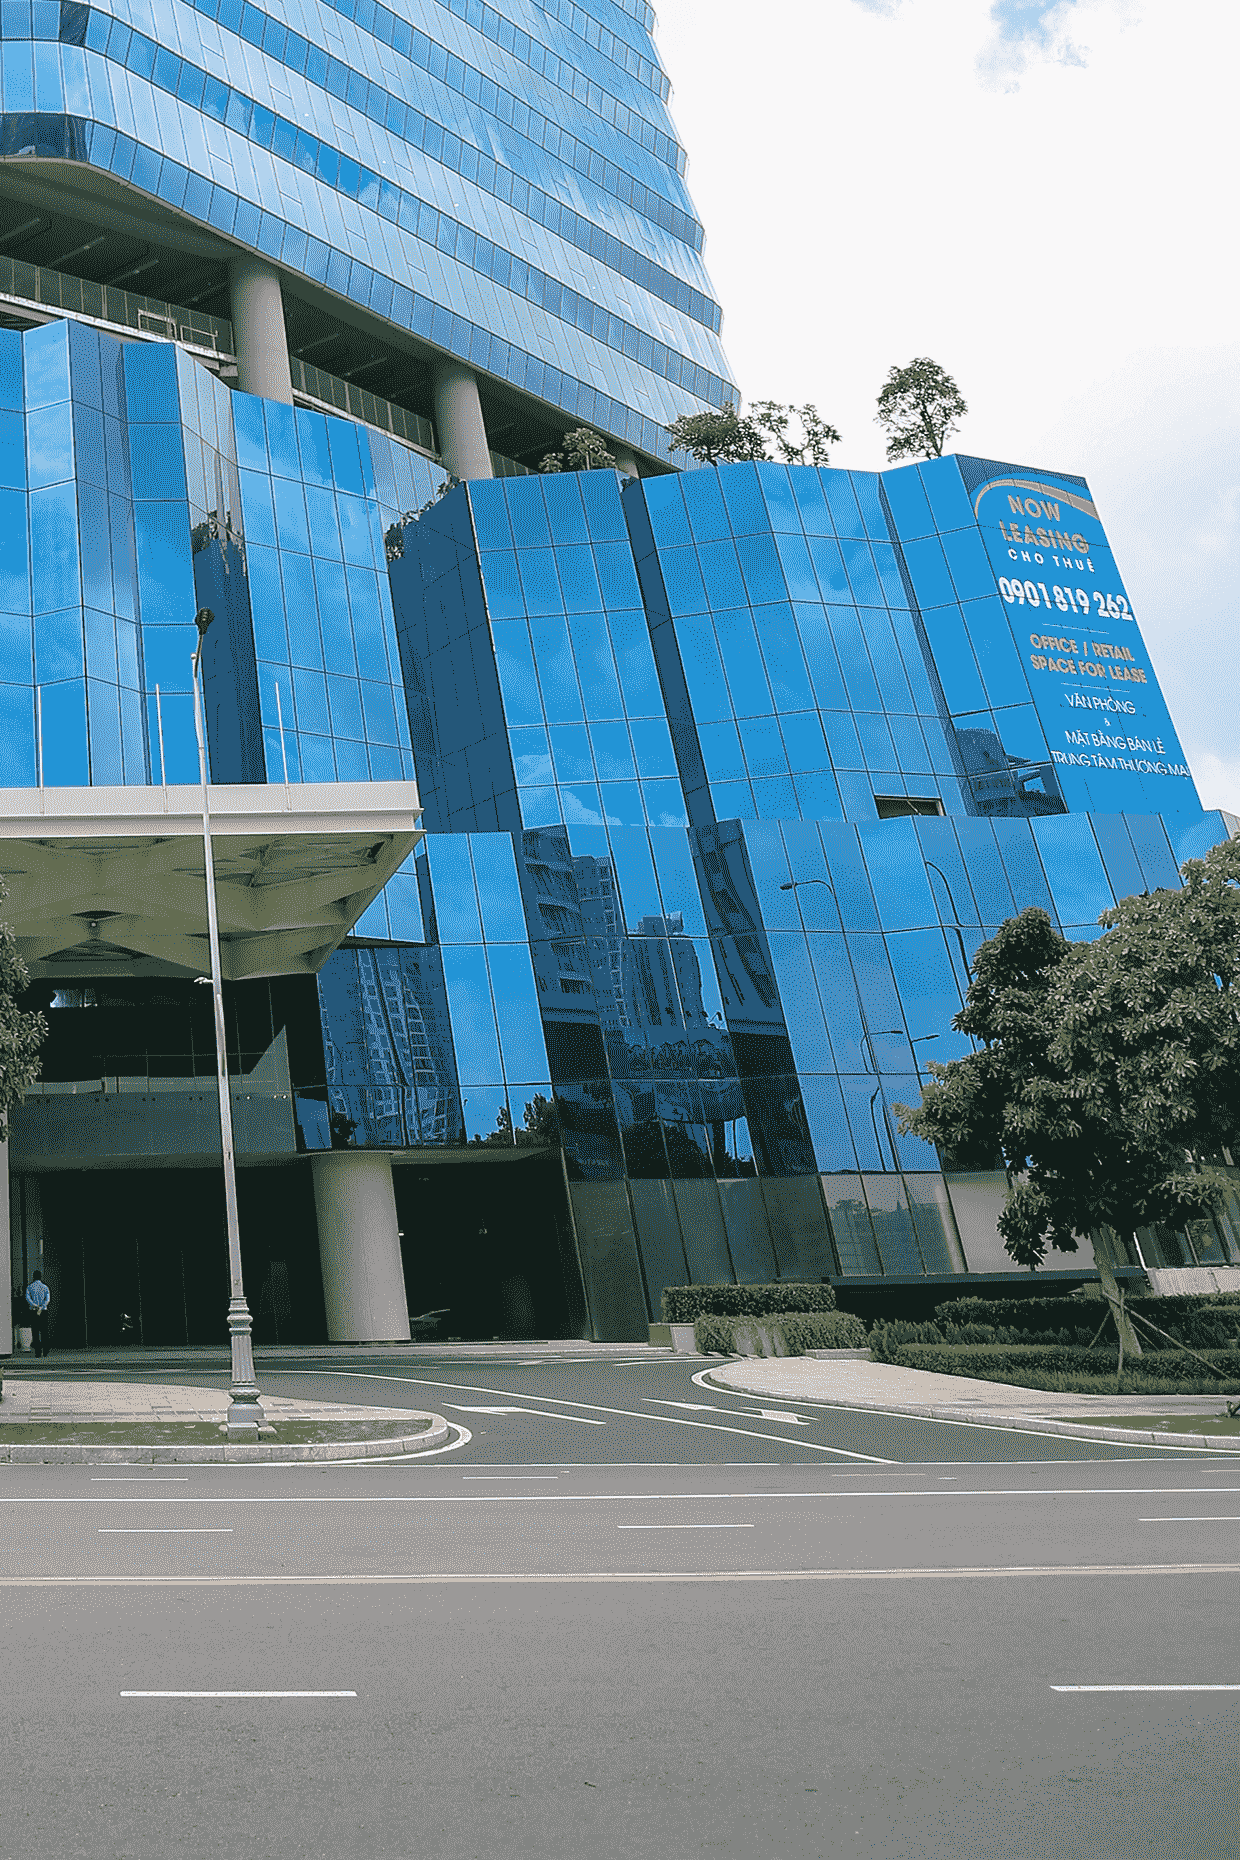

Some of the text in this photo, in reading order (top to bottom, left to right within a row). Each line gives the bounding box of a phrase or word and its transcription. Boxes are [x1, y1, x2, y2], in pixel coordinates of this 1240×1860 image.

[1008, 495, 1060, 521] NOW
[999, 520, 1089, 554] LEASING
[1008, 548, 1044, 564] CHO
[1093, 591, 1134, 621] 262
[1030, 634, 1079, 654] OFFICE
[1091, 642, 1135, 661] RETAIL
[1030, 654, 1147, 683] SPACE FOR LEASE
[1051, 750, 1090, 767] TRUNG
